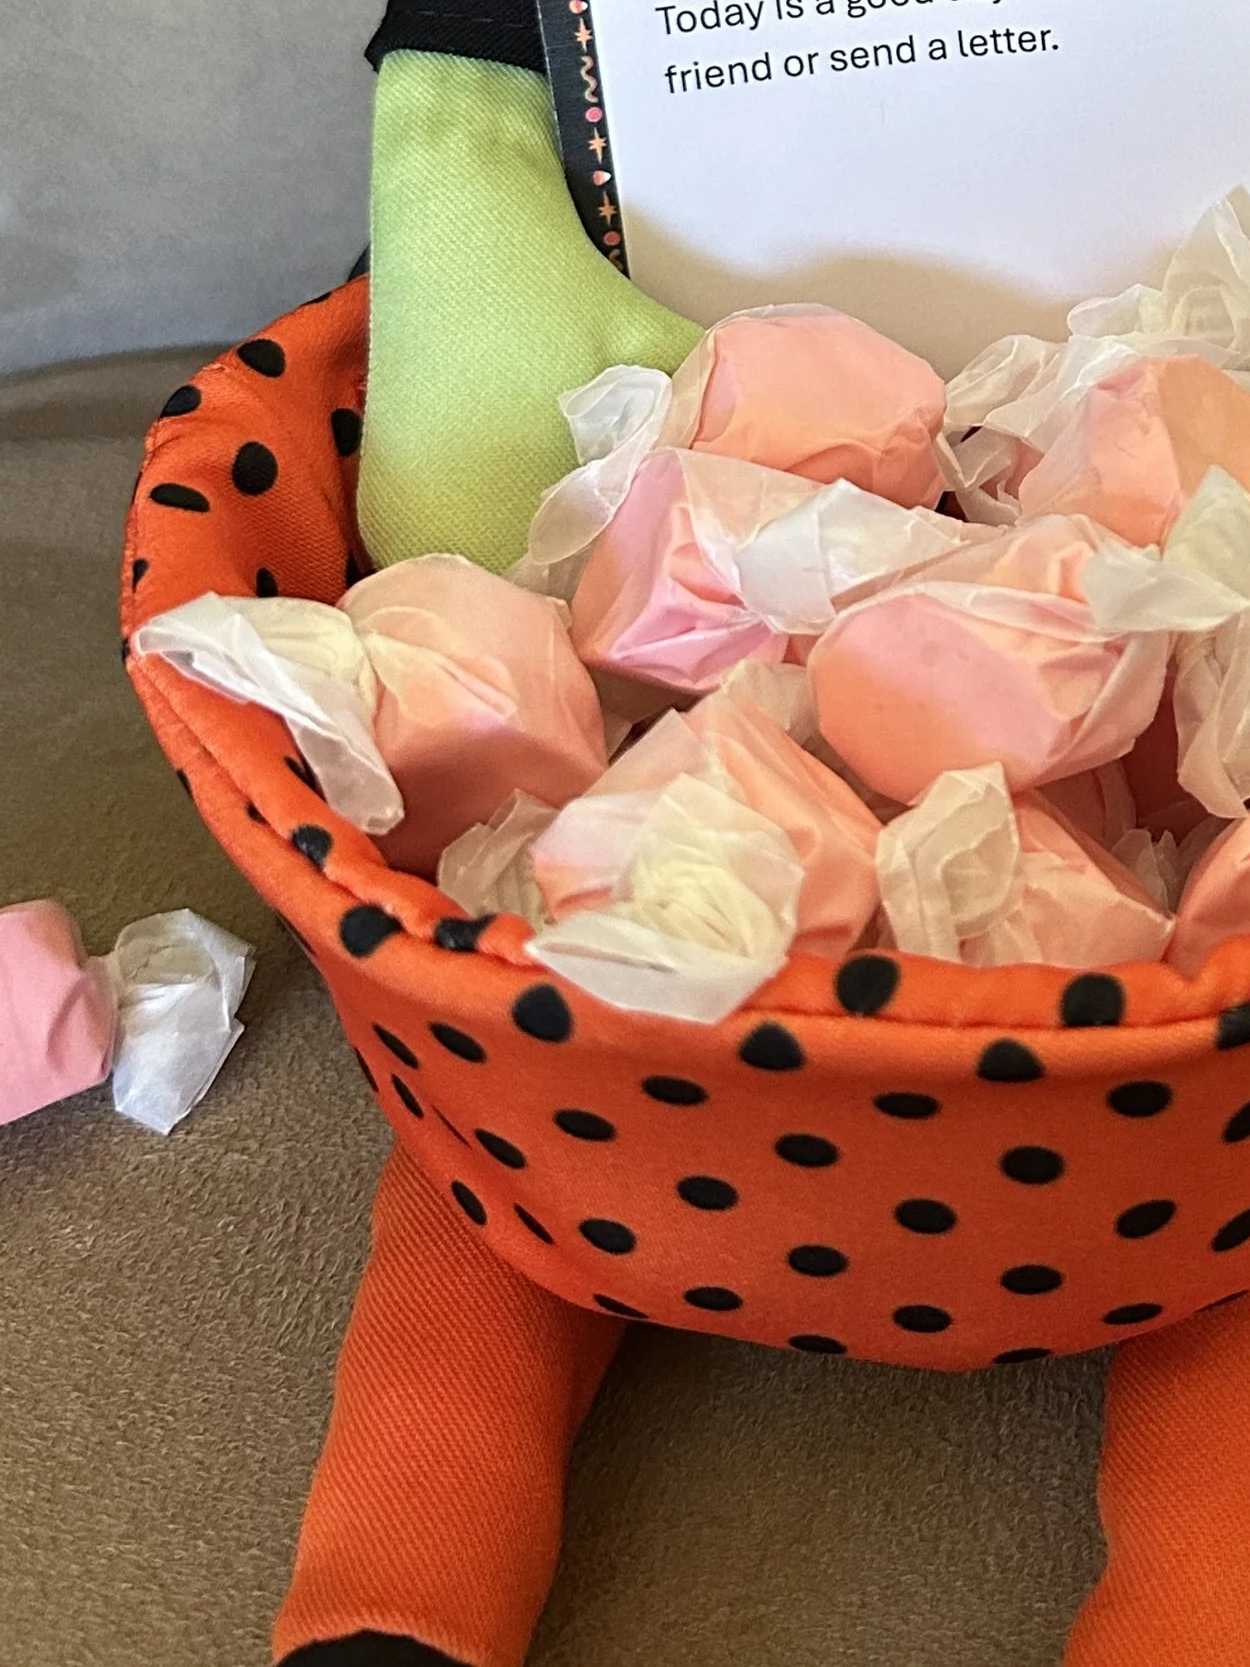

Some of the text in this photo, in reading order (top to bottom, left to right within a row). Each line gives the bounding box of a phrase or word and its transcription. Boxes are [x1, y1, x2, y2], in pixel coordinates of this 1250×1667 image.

[654, 0, 764, 35] Today
[664, 27, 1059, 94] friend or send a letter.
